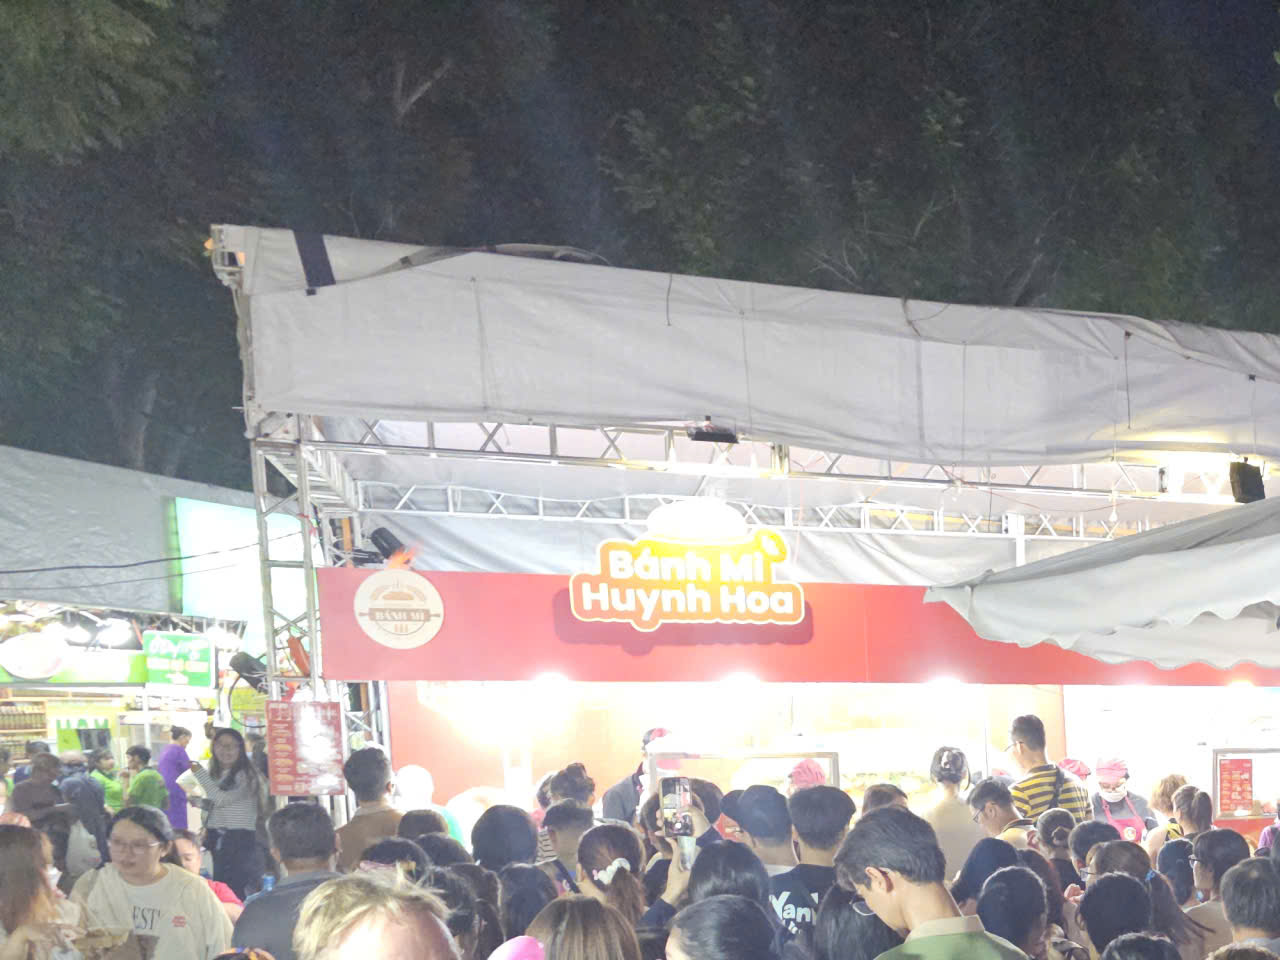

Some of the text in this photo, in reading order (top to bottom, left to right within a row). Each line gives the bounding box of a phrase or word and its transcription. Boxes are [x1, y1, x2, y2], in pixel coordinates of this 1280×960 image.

[609, 547, 712, 581] Bánh
[581, 582, 793, 621] Huynh Hoa
